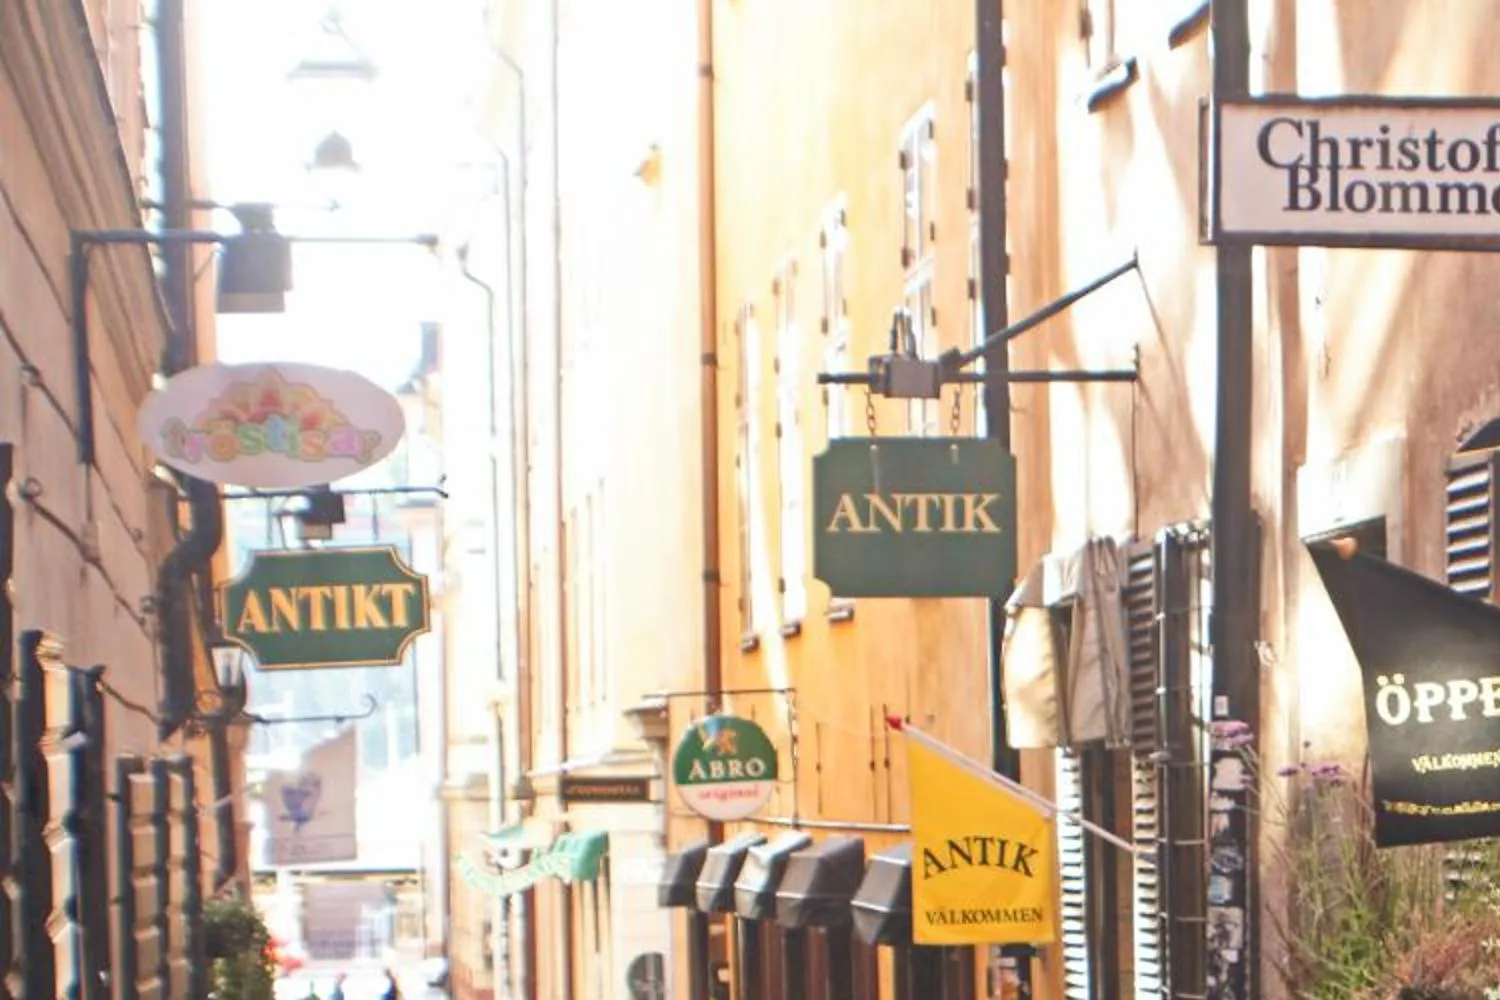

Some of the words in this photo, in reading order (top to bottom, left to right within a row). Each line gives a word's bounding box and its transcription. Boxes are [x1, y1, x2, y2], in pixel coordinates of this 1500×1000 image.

[825, 492, 1002, 533] ANTIK
[236, 581, 415, 634] ANTIKT
[922, 834, 1040, 881] ANTIK
